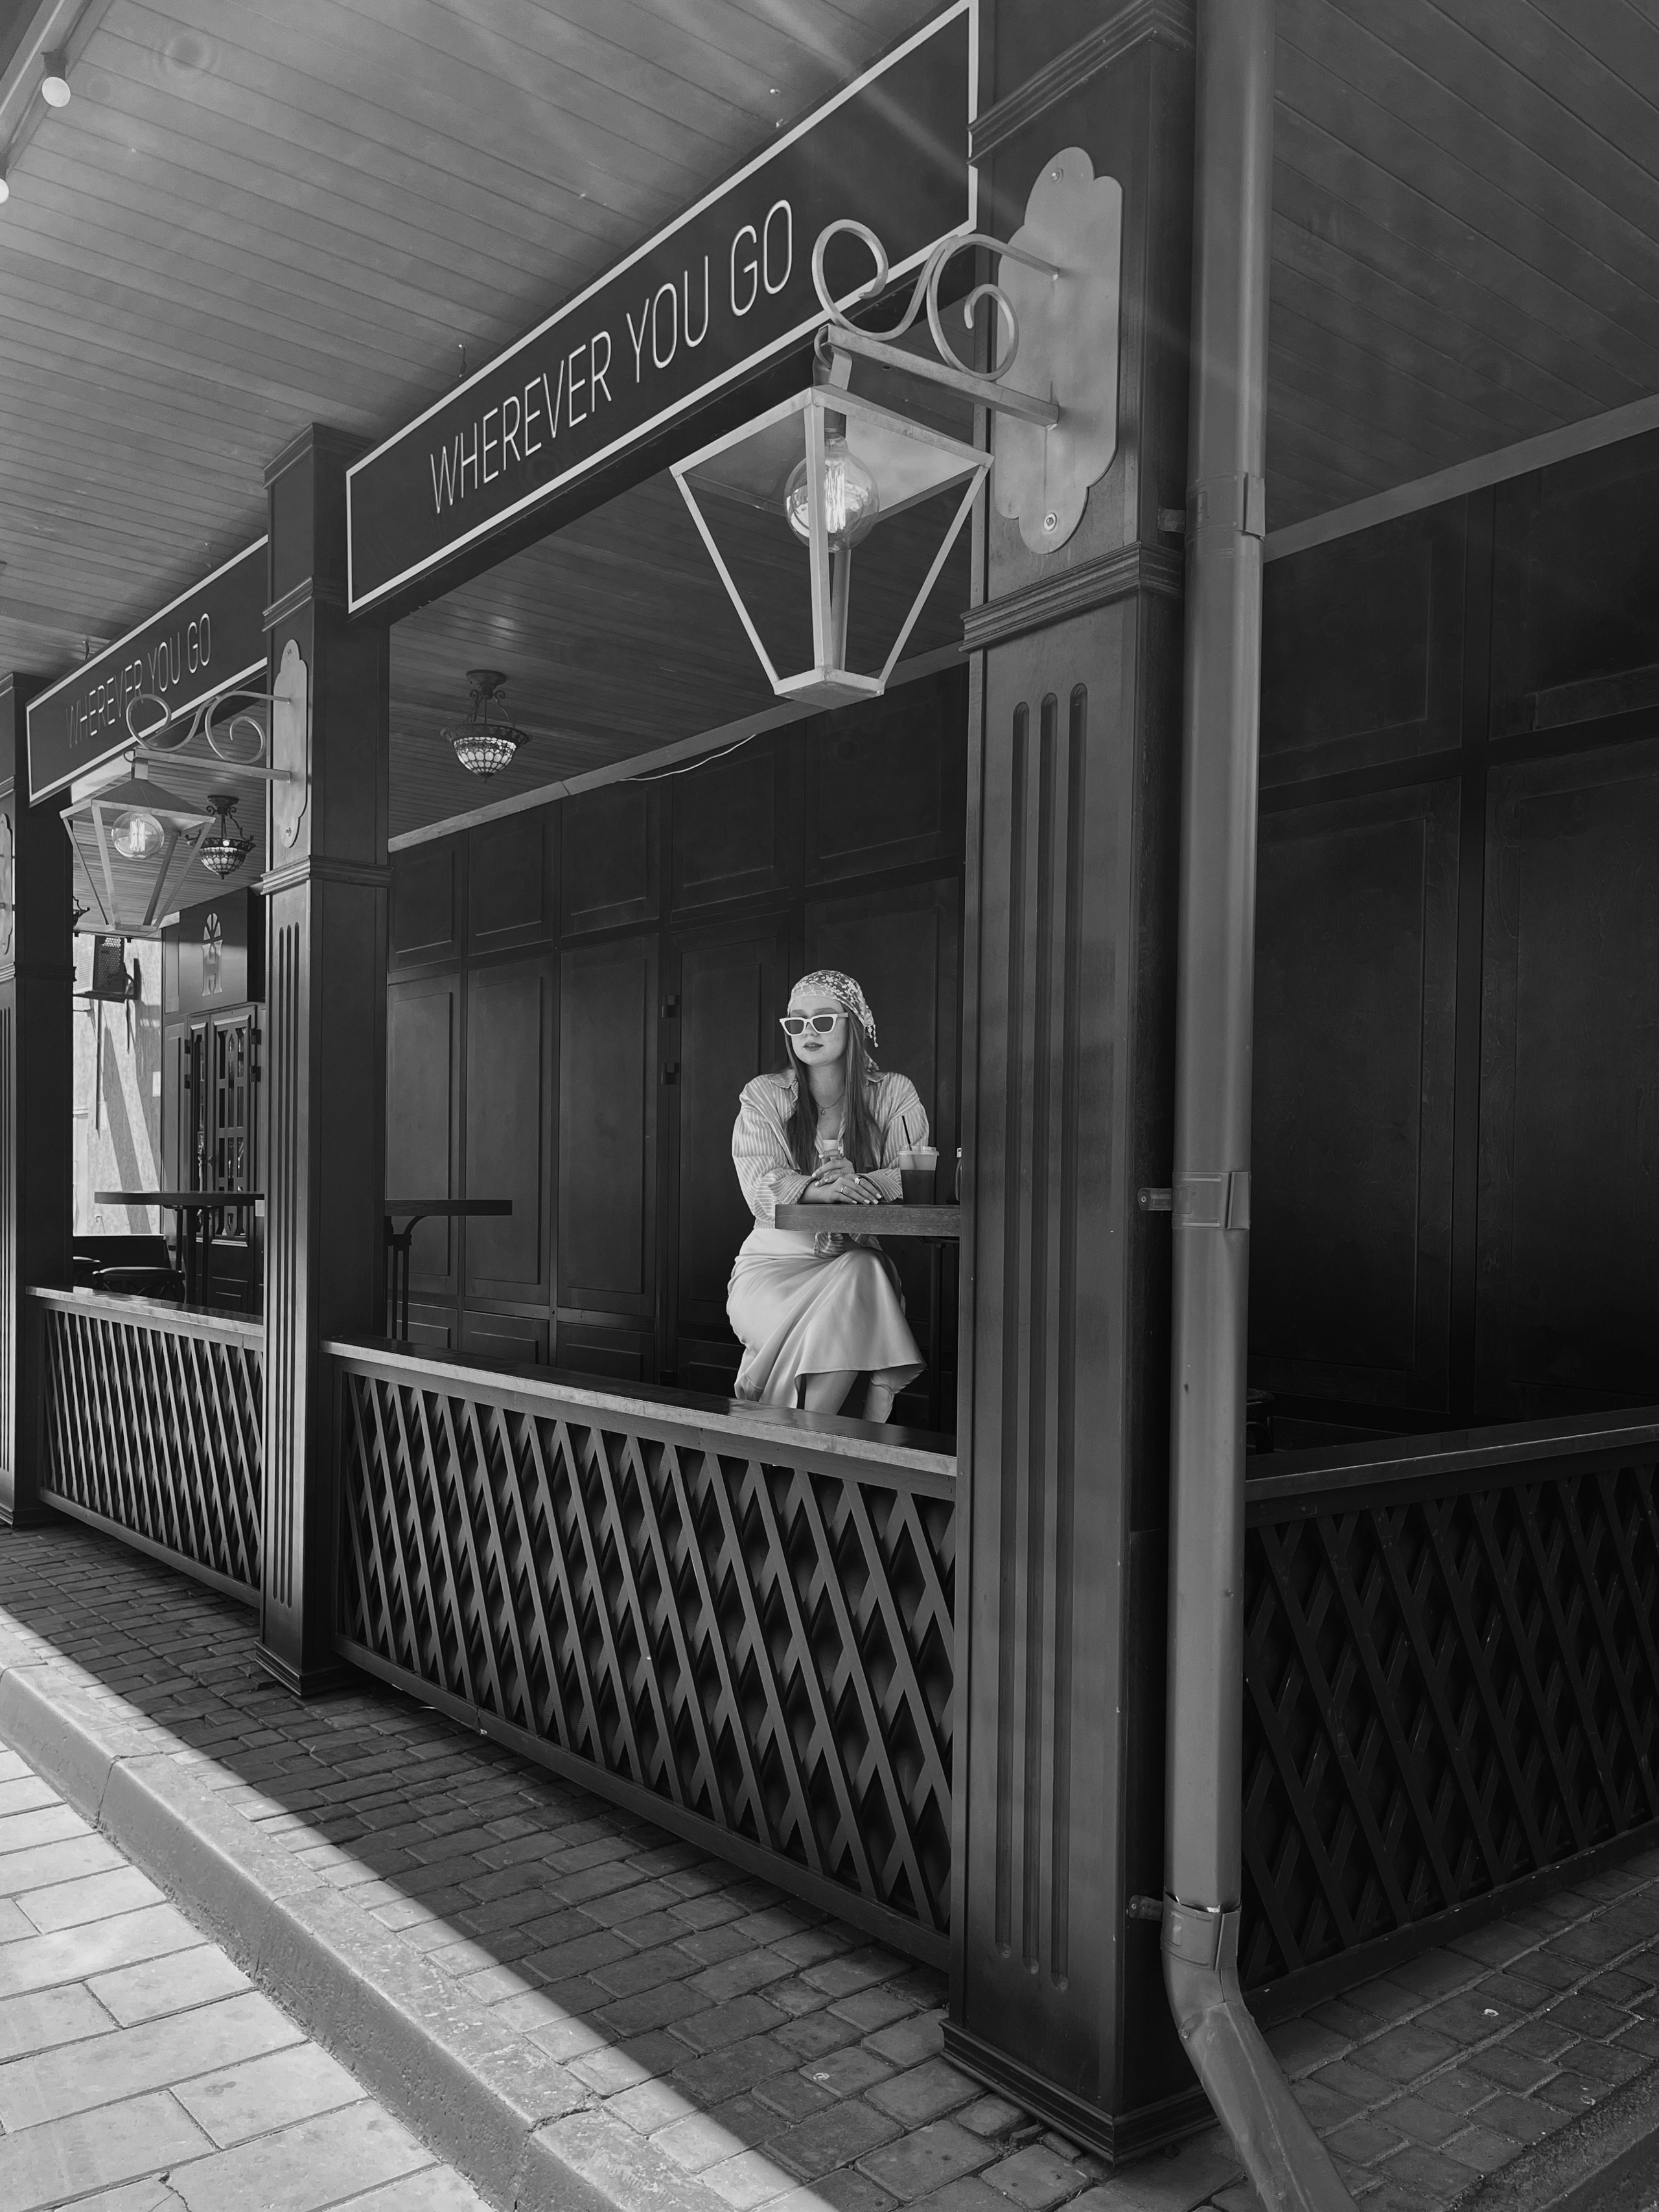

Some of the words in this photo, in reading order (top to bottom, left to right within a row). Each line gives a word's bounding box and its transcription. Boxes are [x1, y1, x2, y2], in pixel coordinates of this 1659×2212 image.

[430, 331, 612, 514] WHEREVER
[626, 256, 709, 384] YOU
[730, 200, 793, 317] GO
[65, 659, 144, 748] WHEREVER
[148, 632, 181, 695] YOU
[187, 613, 211, 674] GO
